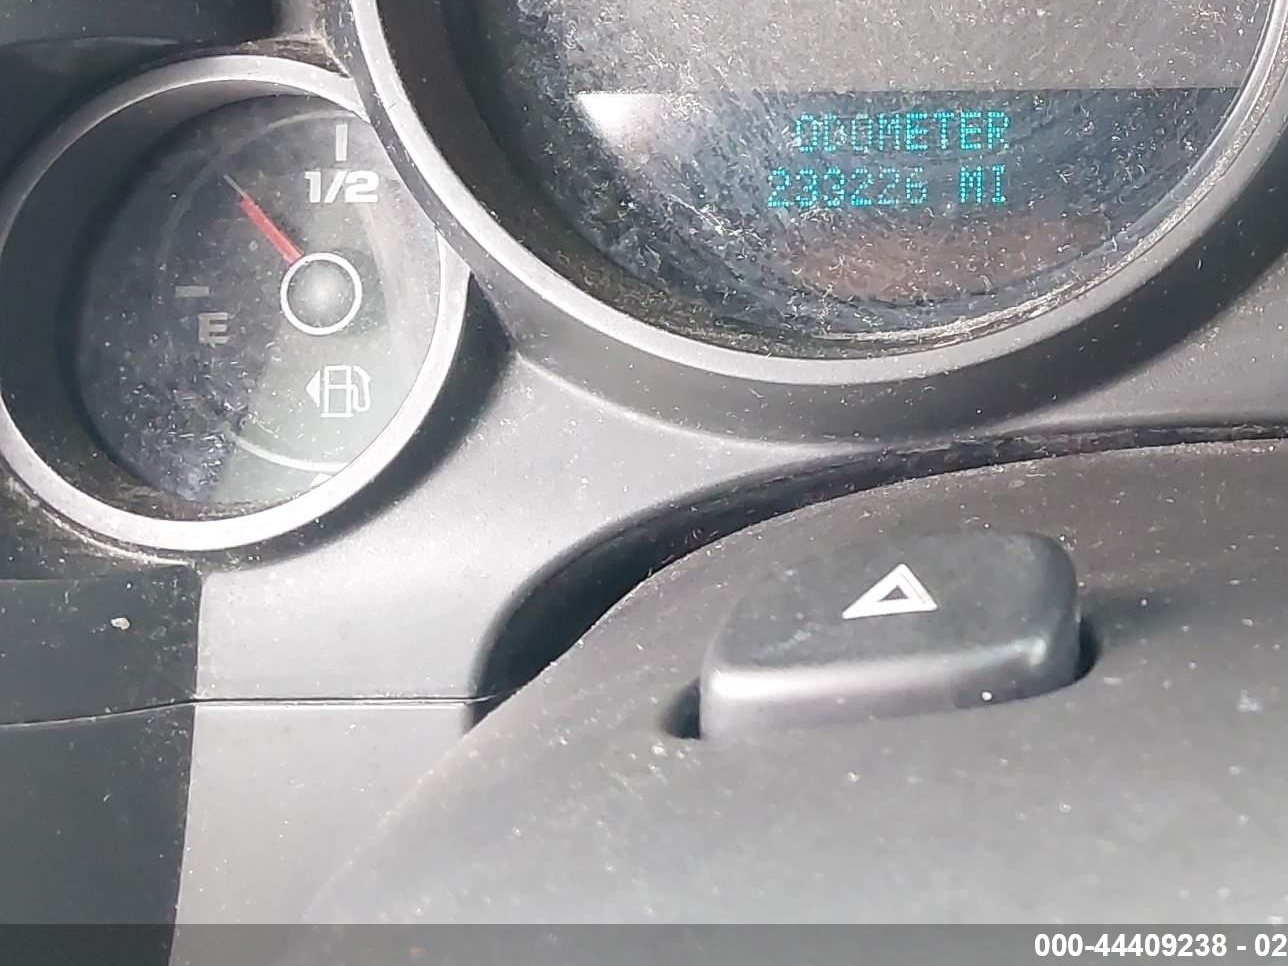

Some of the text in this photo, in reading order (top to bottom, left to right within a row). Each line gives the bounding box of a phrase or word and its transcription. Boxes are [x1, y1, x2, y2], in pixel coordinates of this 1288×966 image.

[796, 111, 1010, 153] ODOMETER
[304, 171, 379, 204] 1/2
[767, 164, 1006, 208] 233226 MI
[199, 312, 230, 344] E
